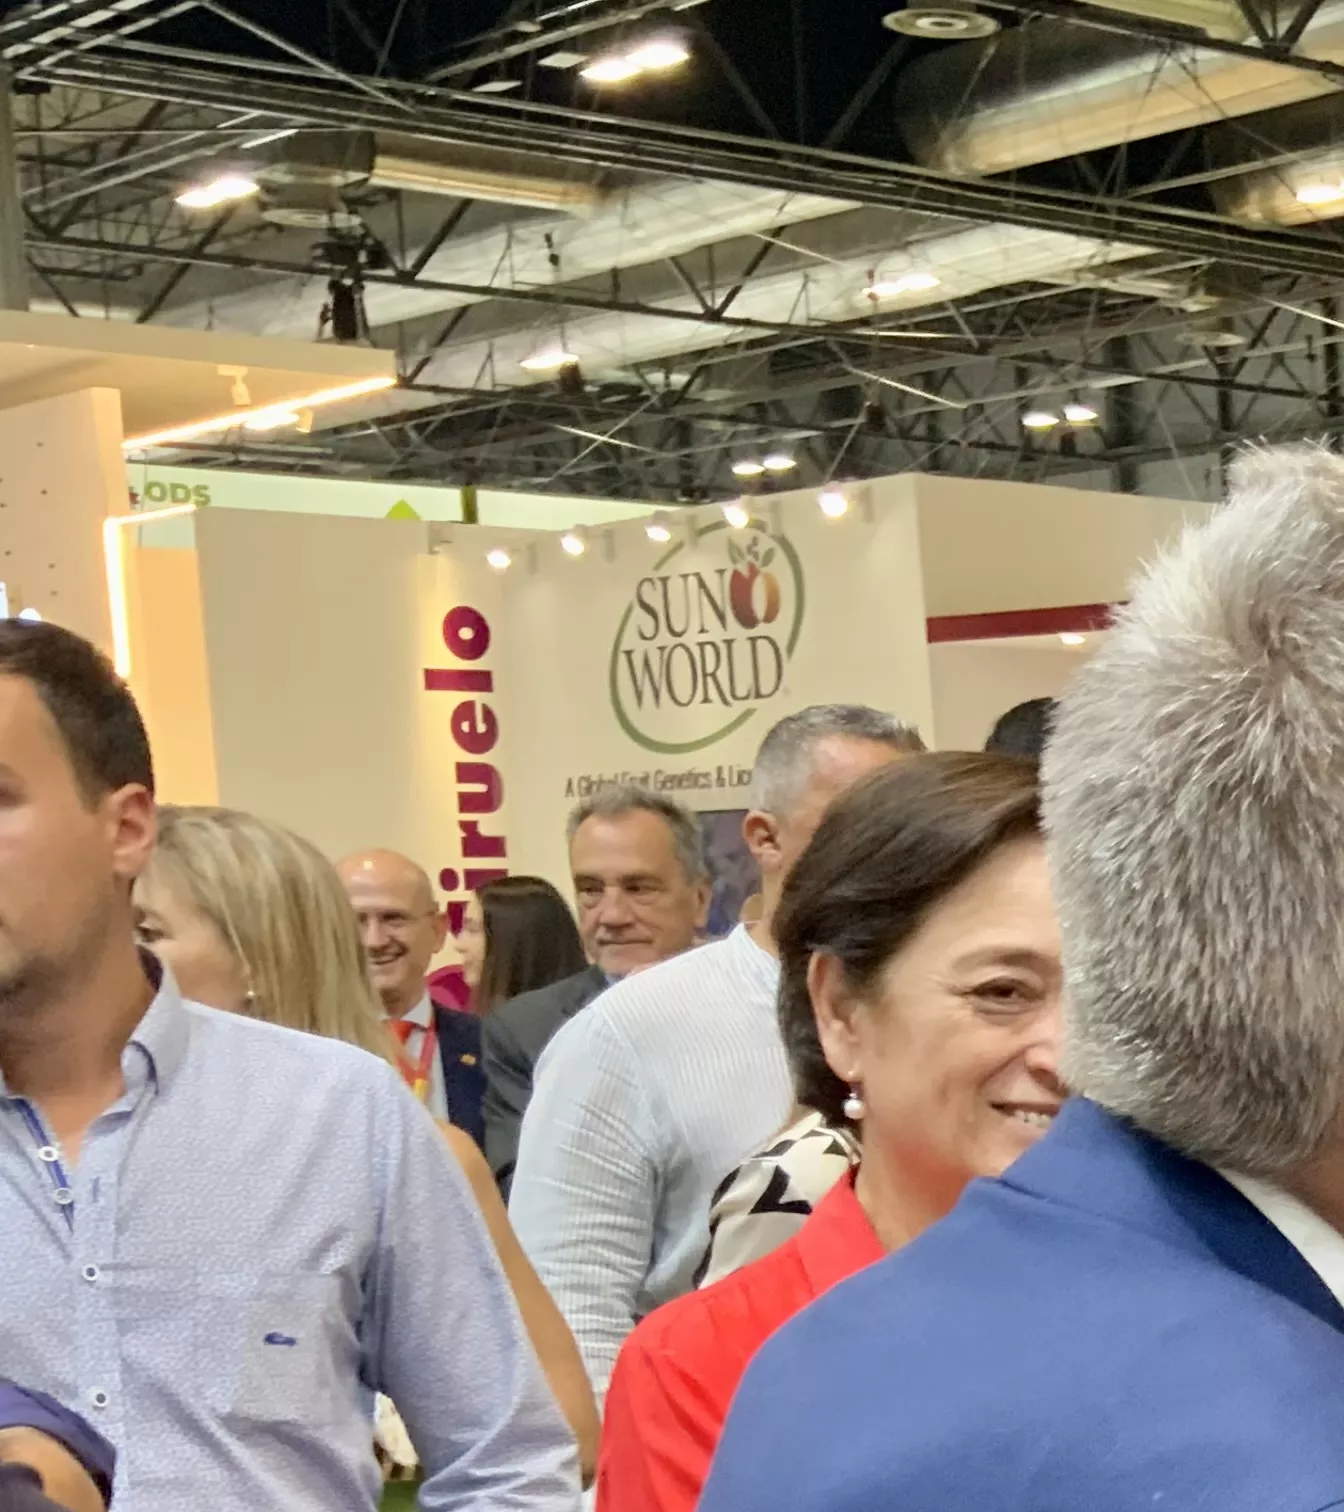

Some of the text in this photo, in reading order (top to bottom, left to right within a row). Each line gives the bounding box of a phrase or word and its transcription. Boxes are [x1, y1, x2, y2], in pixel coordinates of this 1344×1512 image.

[635, 568, 728, 642] SUN
[621, 634, 784, 710] WORLD
[423, 605, 509, 938] iruelo
